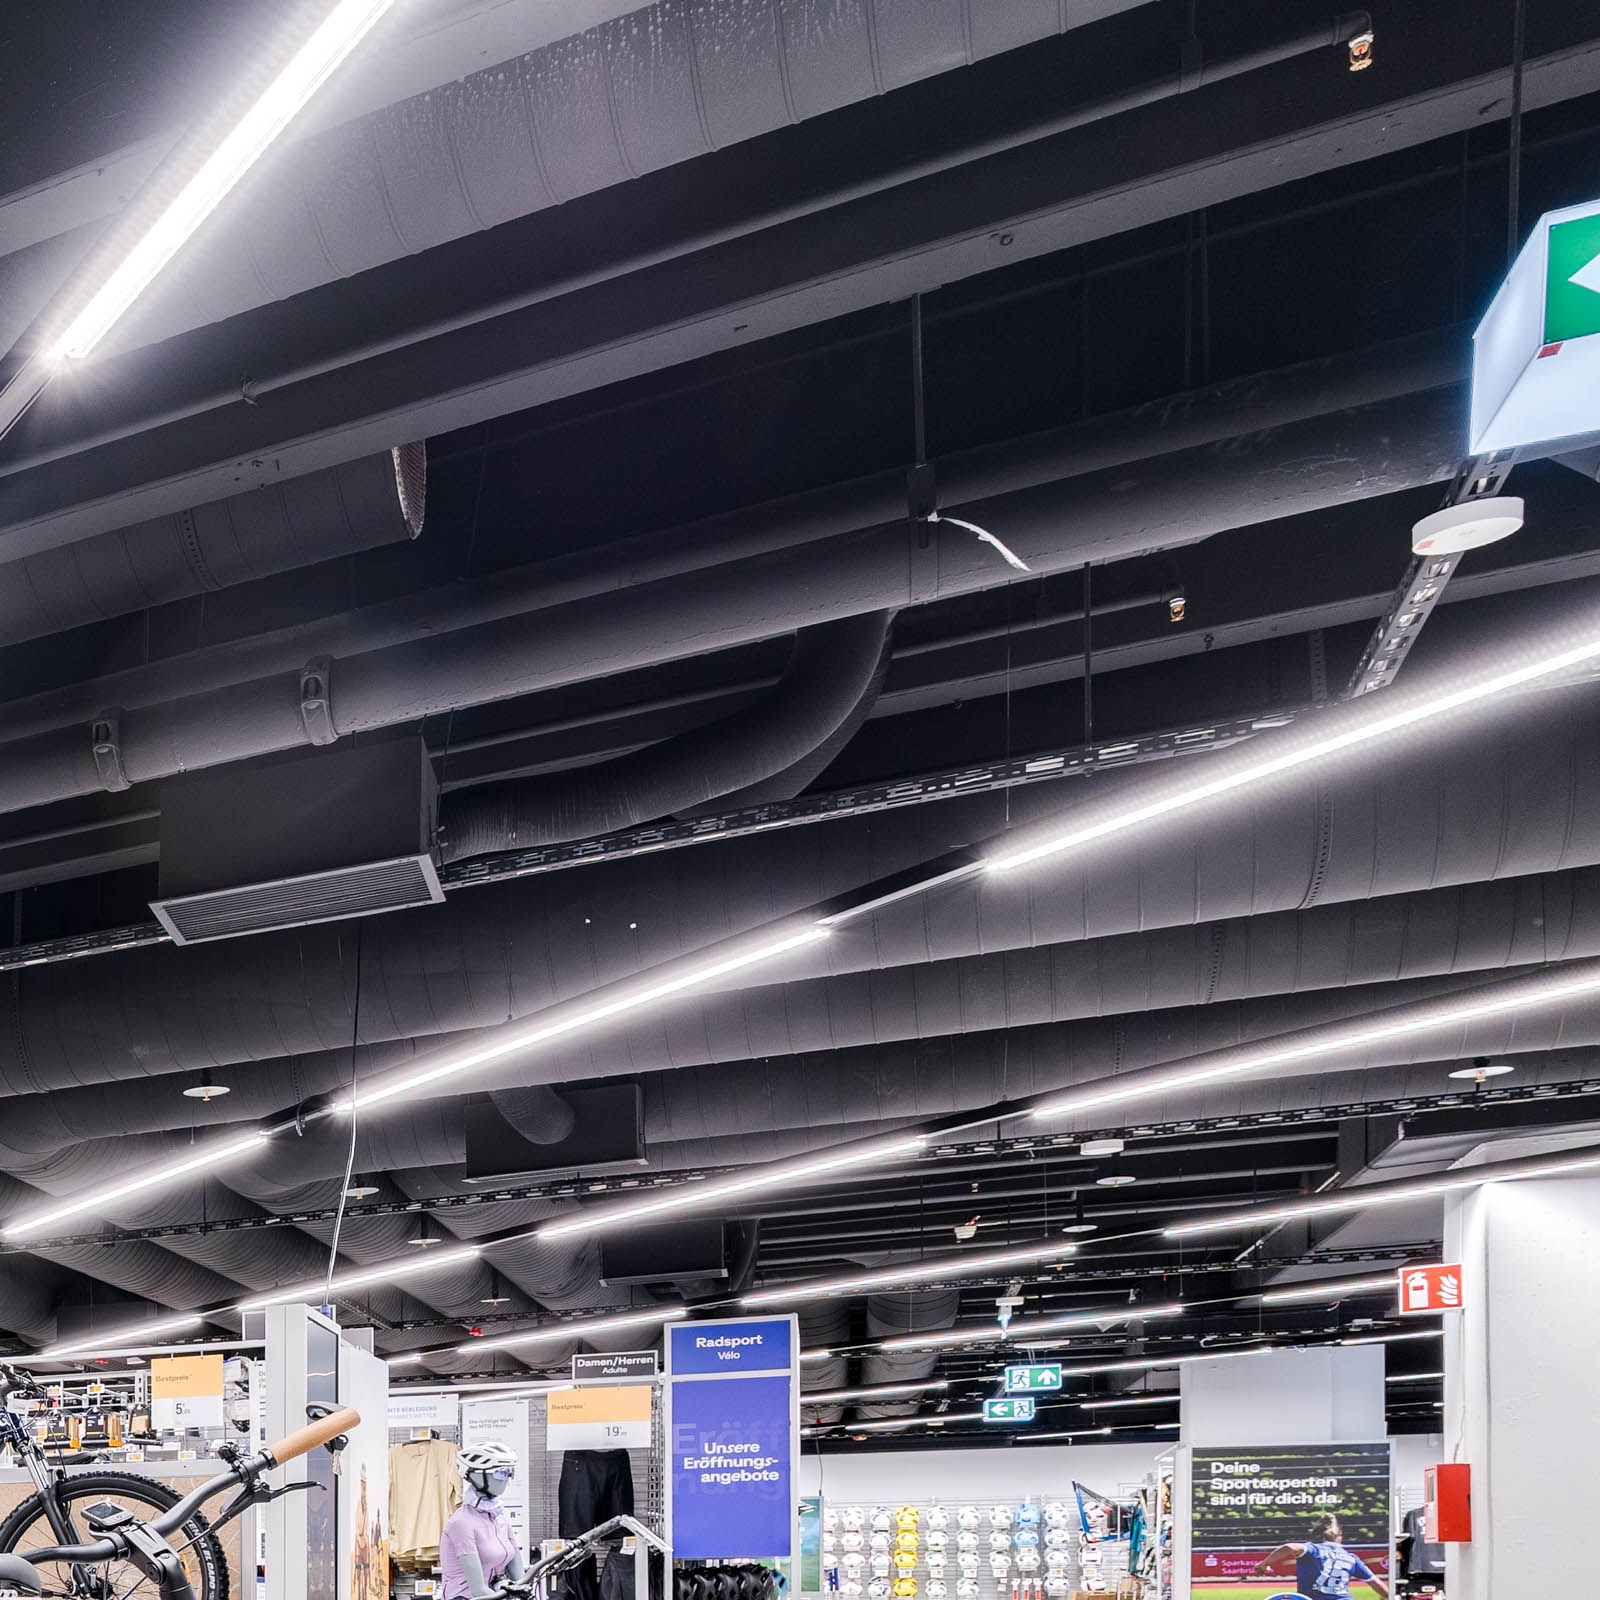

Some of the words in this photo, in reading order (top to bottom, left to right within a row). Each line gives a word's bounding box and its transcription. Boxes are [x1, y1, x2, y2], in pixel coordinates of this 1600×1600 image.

[696, 1334, 763, 1348] Radsport
[577, 1356, 654, 1368] Damen/Herren
[717, 1351, 741, 1360] Vélo
[704, 1442, 760, 1455] Unsere
[683, 1456, 779, 1470] Eröffnungs-
[1211, 1461, 1260, 1474] Deine
[700, 1469, 780, 1485] angebote
[1210, 1477, 1338, 1491] Sportexperten
[1211, 1493, 1246, 1506] sind
[1248, 1492, 1274, 1505] für
[1275, 1492, 1313, 1505] dich
[1314, 1491, 1343, 1504] da.
[1221, 1559, 1259, 1568] Sparkass
